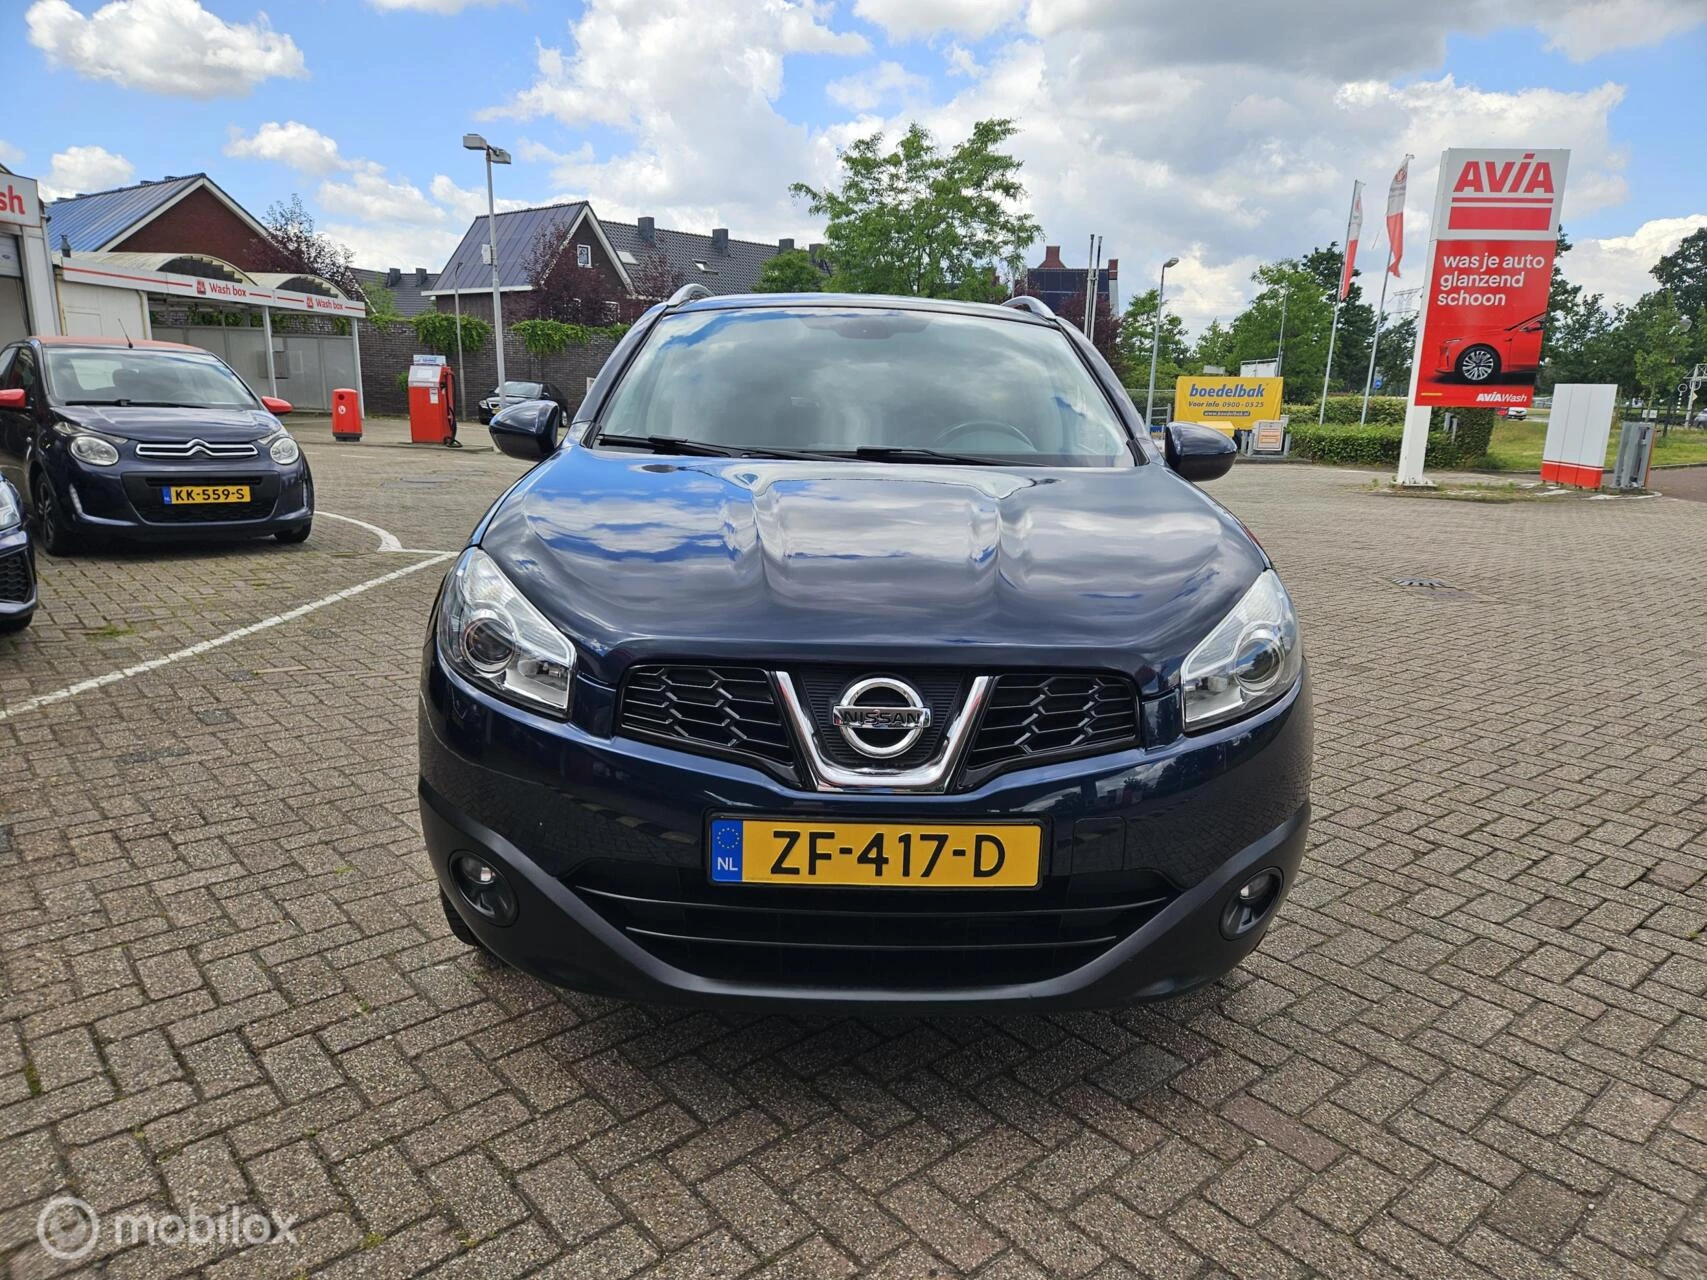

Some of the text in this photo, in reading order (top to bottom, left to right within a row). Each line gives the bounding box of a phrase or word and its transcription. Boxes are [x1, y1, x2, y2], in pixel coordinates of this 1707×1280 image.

[1443, 252, 1545, 272] was je auto
[1440, 271, 1525, 291] glanzend
[209, 282, 247, 297] Wash box
[316, 297, 332, 309] Wash
[1437, 290, 1506, 306] schoon
[1189, 383, 1265, 397] boedelbak
[175, 488, 245, 502] KK-559-S
[842, 711, 921, 724] NISSAN
[717, 830, 1006, 878] NL ZF-417-D
